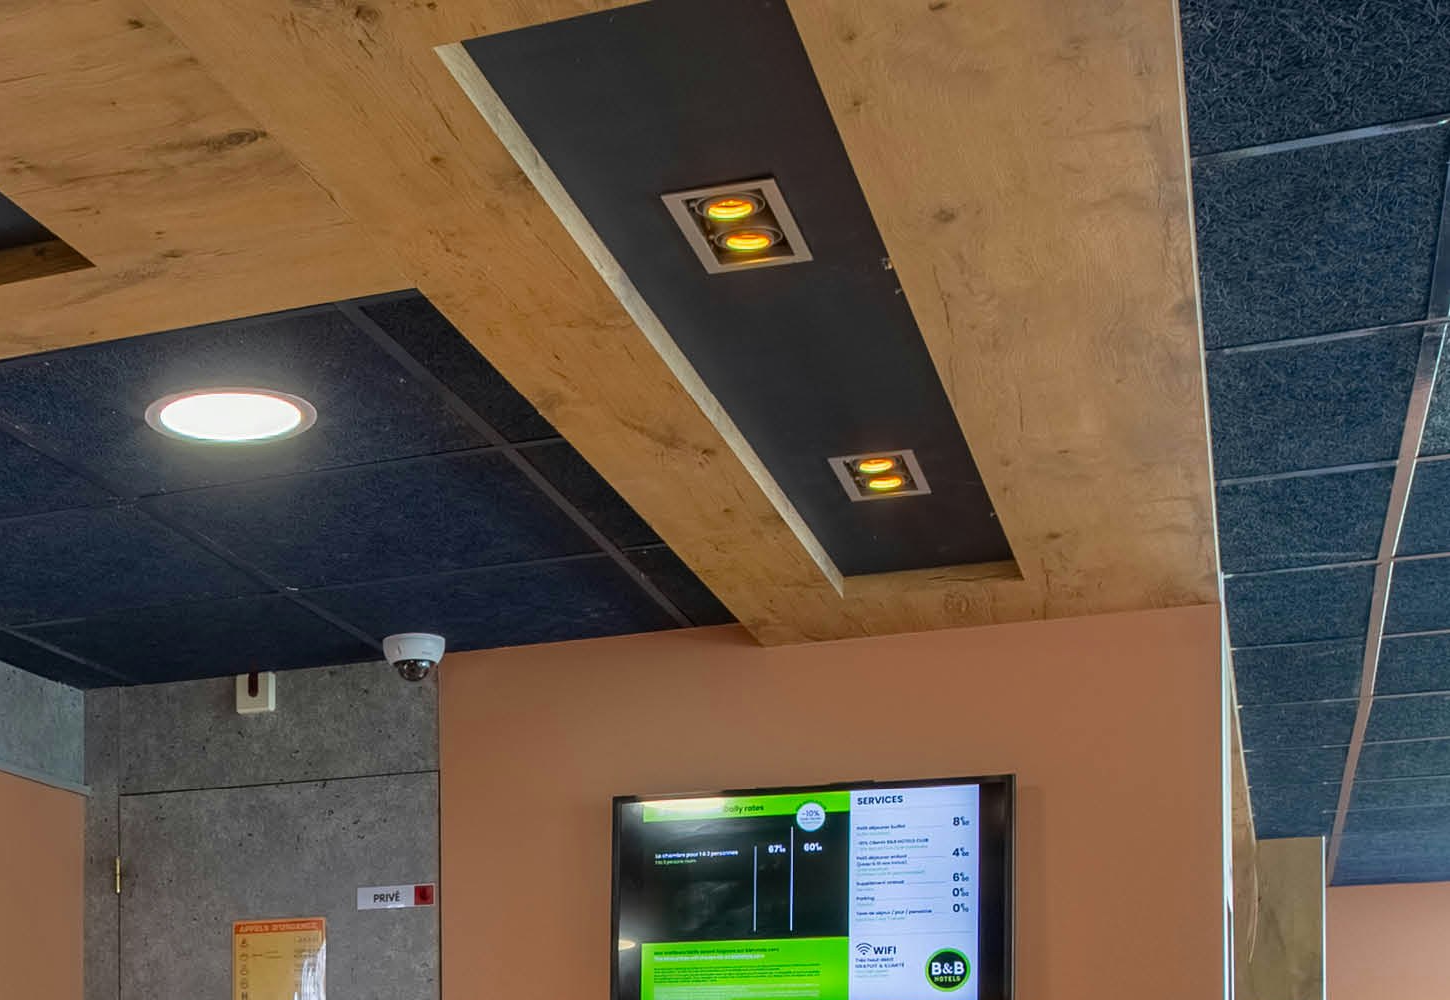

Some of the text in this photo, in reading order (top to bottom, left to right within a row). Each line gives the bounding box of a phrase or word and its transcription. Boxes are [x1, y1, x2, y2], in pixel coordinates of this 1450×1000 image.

[857, 795, 904, 806] SERVICES
[373, 889, 401, 904] PRIVÉ
[873, 945, 897, 955] WIFI
[931, 960, 965, 976] B&B
[933, 975, 961, 983] HOTELS
